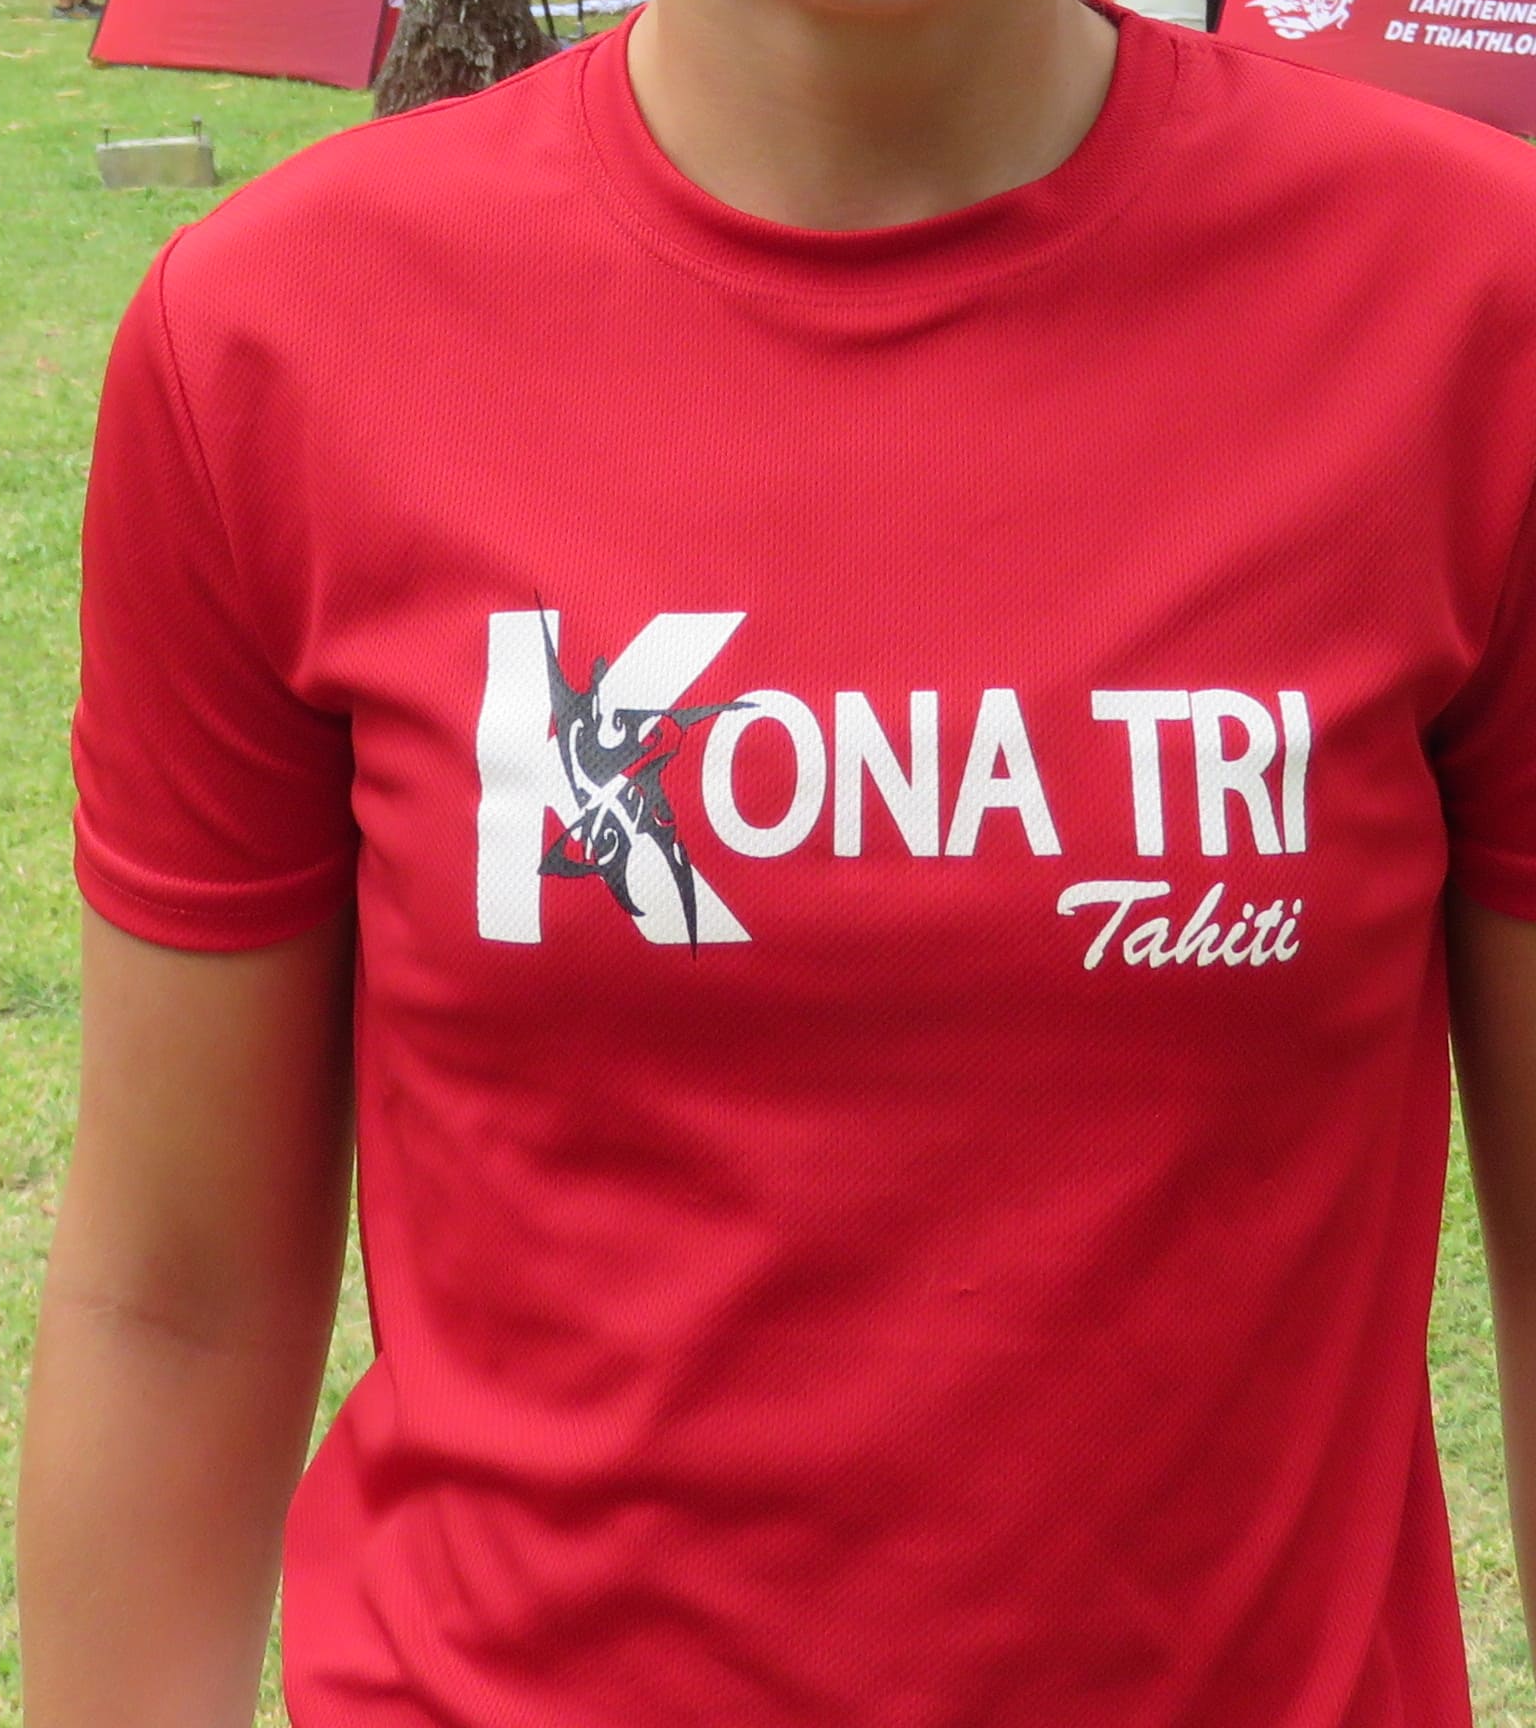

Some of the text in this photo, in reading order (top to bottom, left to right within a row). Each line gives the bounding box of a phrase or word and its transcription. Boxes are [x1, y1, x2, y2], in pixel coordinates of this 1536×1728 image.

[1384, 20, 1419, 43] DE
[476, 609, 1311, 943] KONA TRI
[1056, 879, 1302, 970] Tahiti
